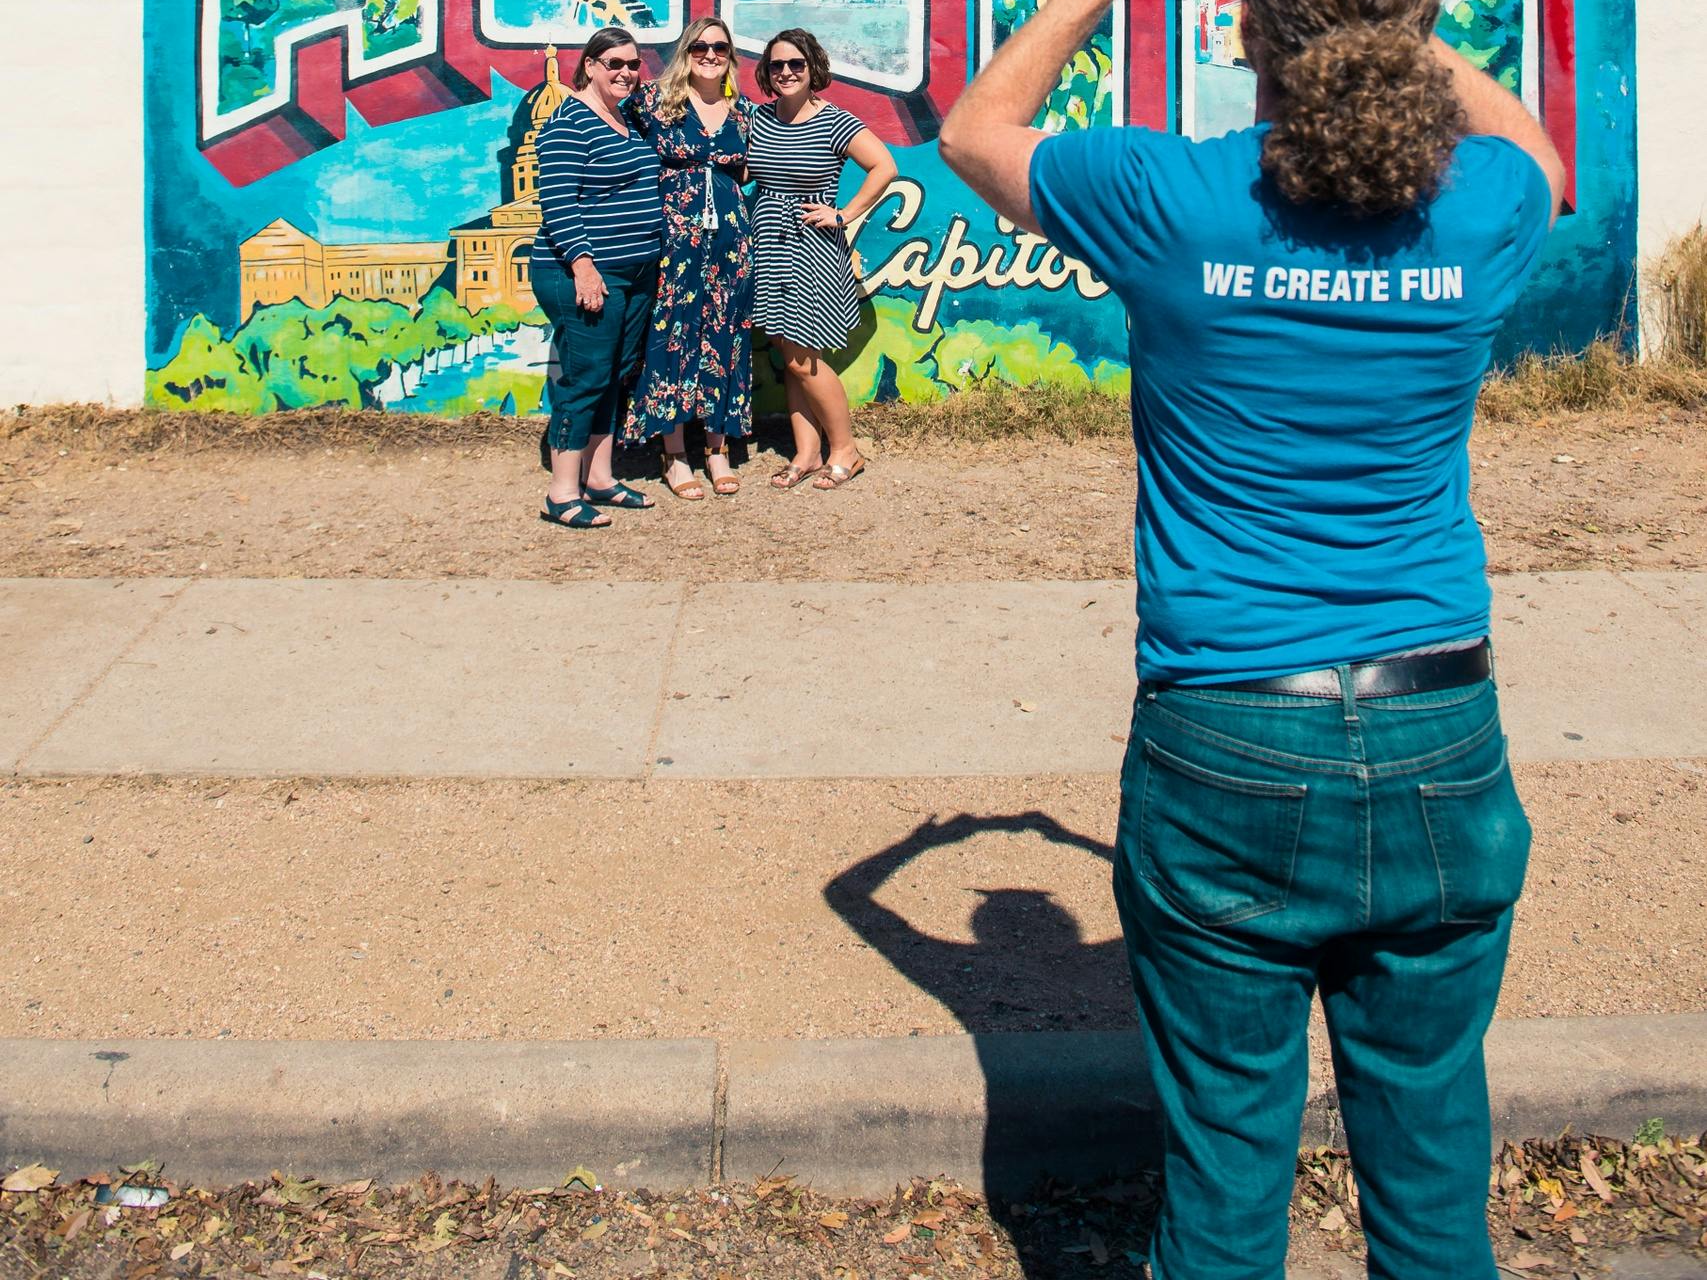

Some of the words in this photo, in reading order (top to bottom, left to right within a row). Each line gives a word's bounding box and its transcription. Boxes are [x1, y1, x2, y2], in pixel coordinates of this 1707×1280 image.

[1203, 261, 1255, 298] WE
[1264, 266, 1390, 302] CREATE
[1401, 266, 1463, 302] FUN
